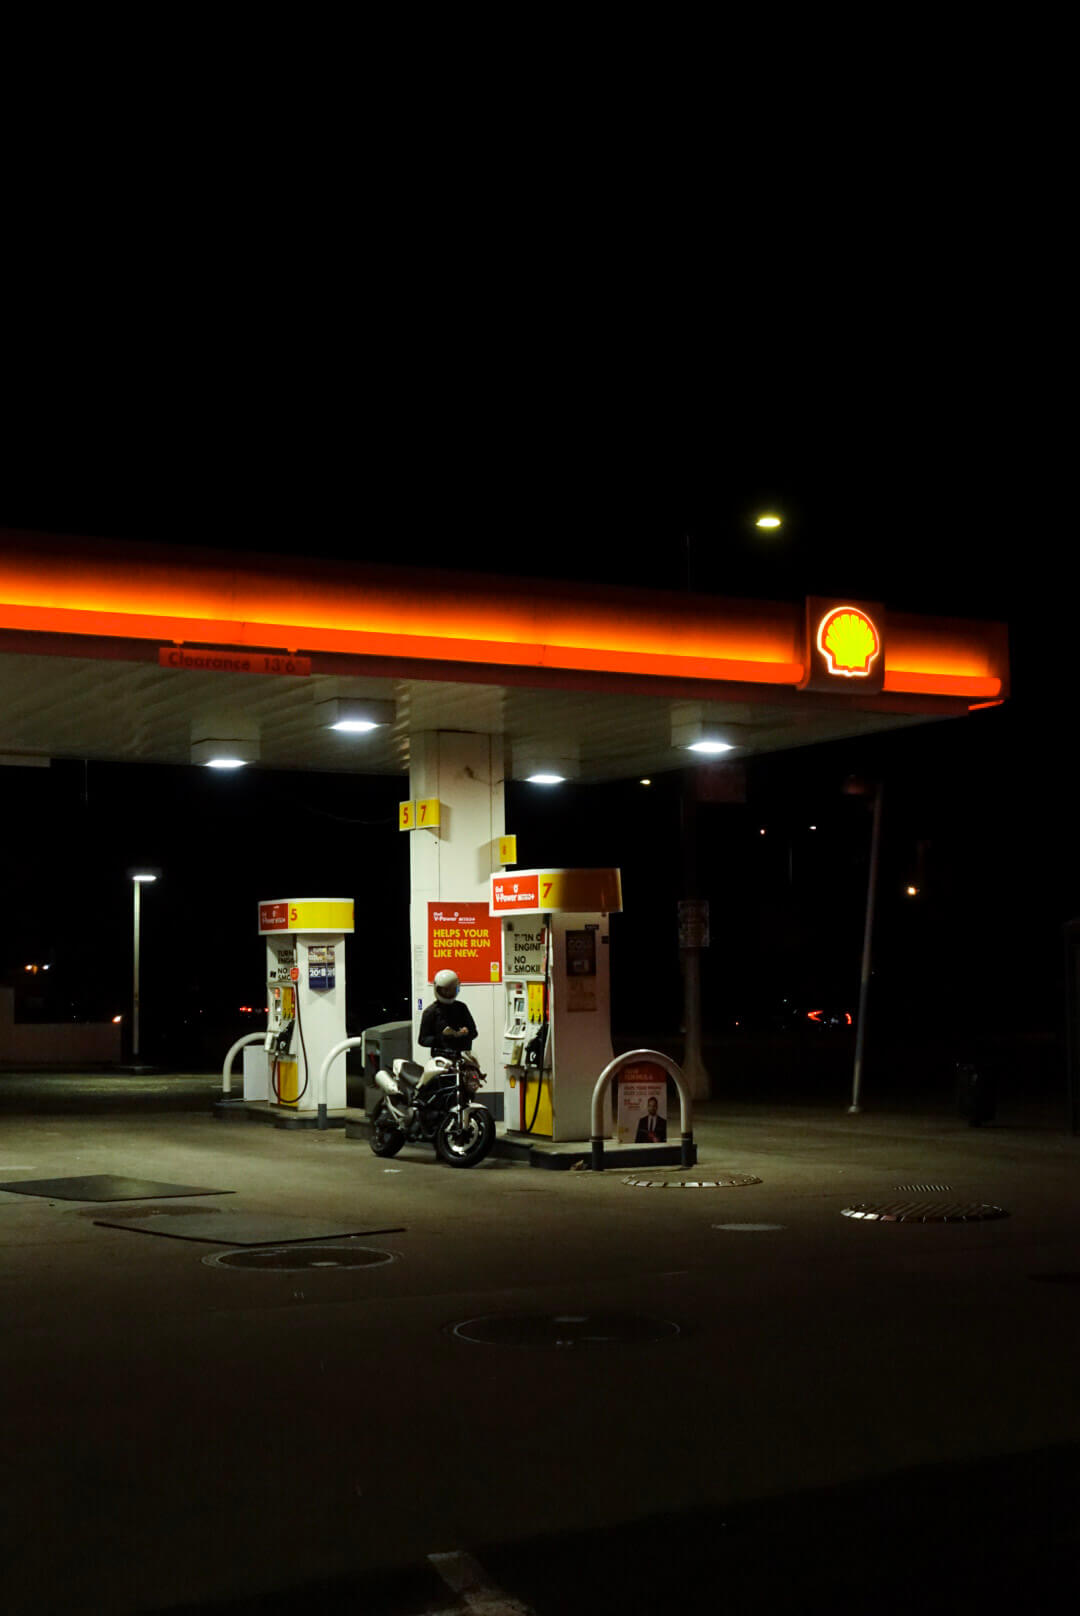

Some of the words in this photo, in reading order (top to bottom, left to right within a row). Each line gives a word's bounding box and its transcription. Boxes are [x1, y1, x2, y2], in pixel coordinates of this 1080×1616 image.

[168, 651, 250, 671] Clearance
[403, 807, 409, 824] 5
[420, 804, 427, 823] 7
[543, 883, 553, 898] 7
[290, 908, 298, 921] 5
[433, 928, 461, 938] HELPS
[463, 928, 489, 938] YOUR
[433, 938, 468, 948] ENGINE
[470, 938, 491, 948] RUN
[433, 949, 453, 958] LIKE
[454, 949, 479, 958] NEW.
[514, 955, 526, 964] NO
